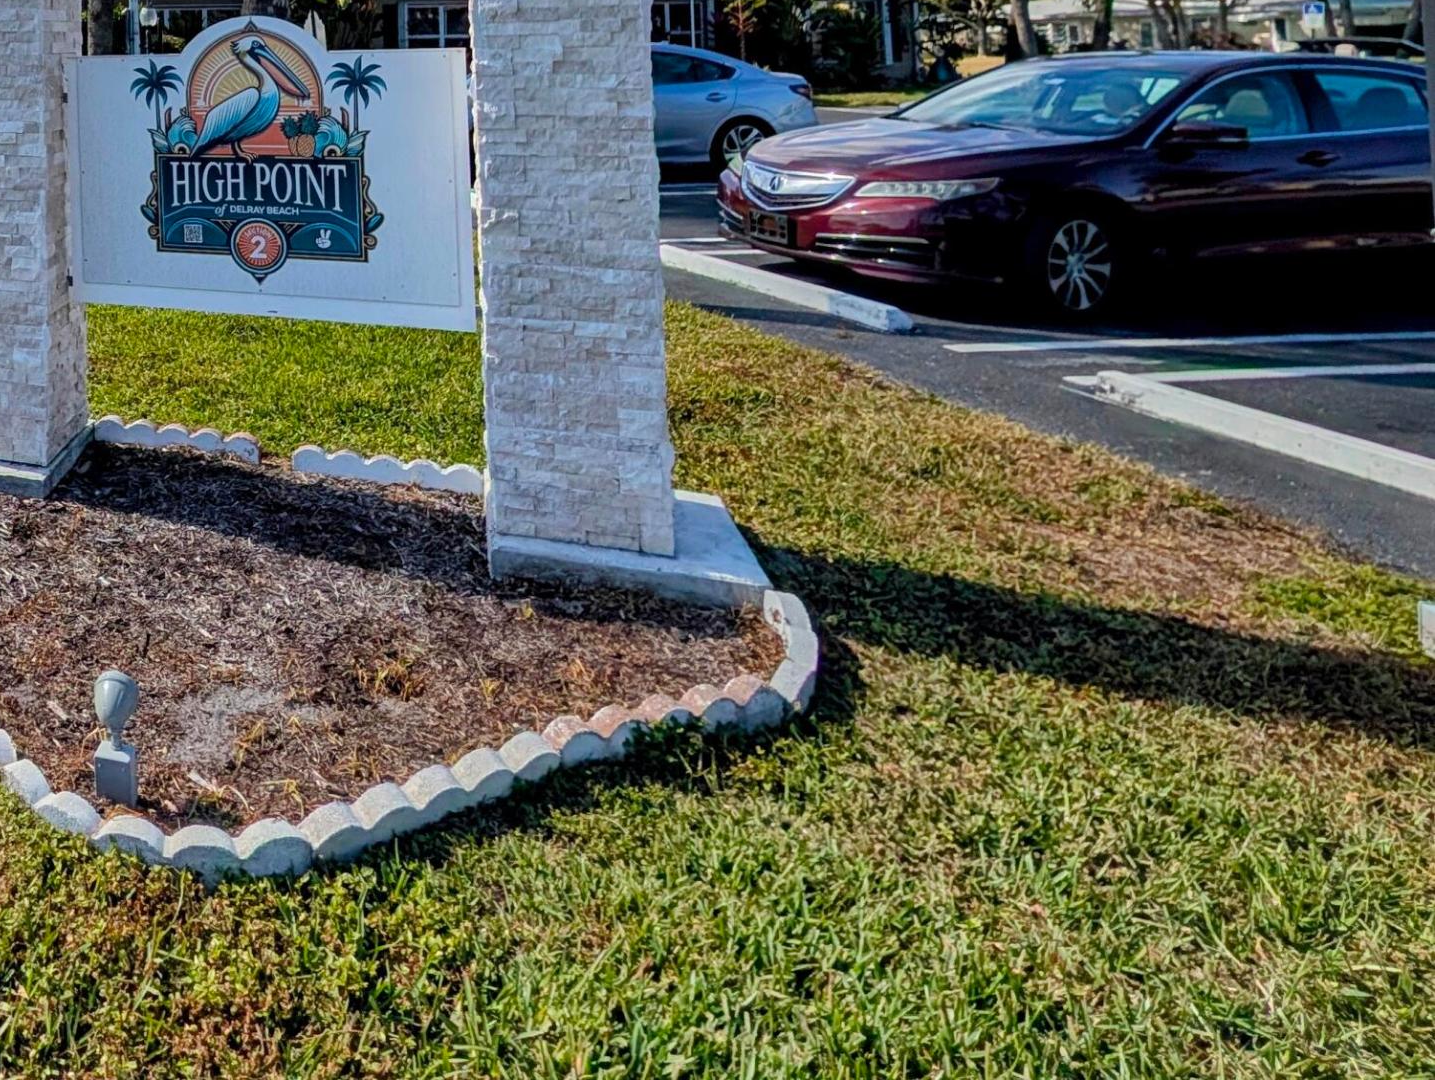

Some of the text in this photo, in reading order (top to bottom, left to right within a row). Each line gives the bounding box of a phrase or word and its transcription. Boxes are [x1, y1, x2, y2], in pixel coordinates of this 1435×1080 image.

[170, 161, 347, 212] HIGH POINT
[215, 204, 299, 217] of DELRAY BEACH
[250, 235, 267, 259] 2
